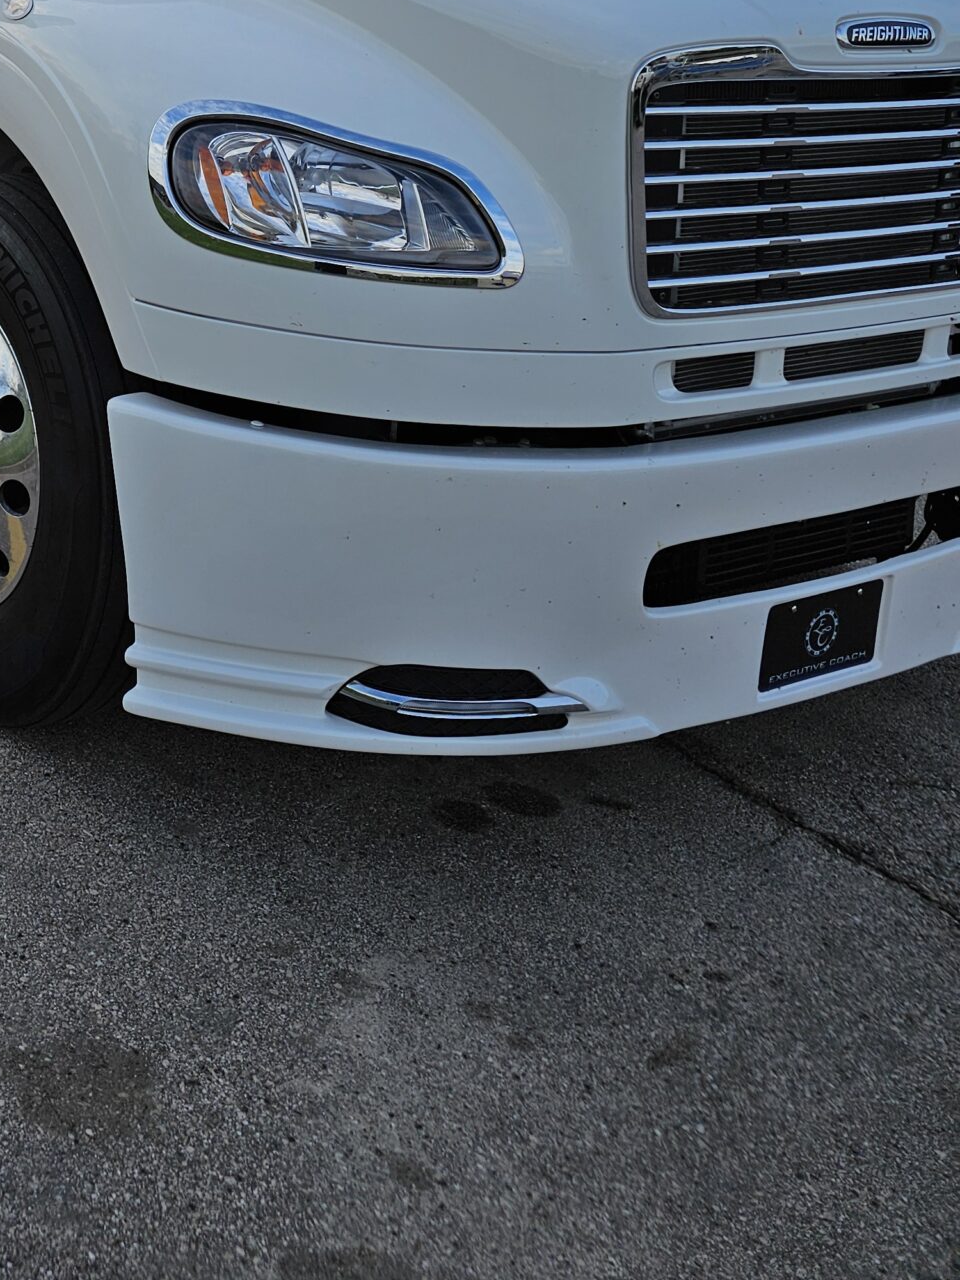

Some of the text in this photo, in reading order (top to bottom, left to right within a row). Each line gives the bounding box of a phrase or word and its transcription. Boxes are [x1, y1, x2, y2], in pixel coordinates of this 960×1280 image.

[851, 25, 928, 41] FREIGHTLINER
[768, 650, 866, 683] EXECUTIVE COACH
